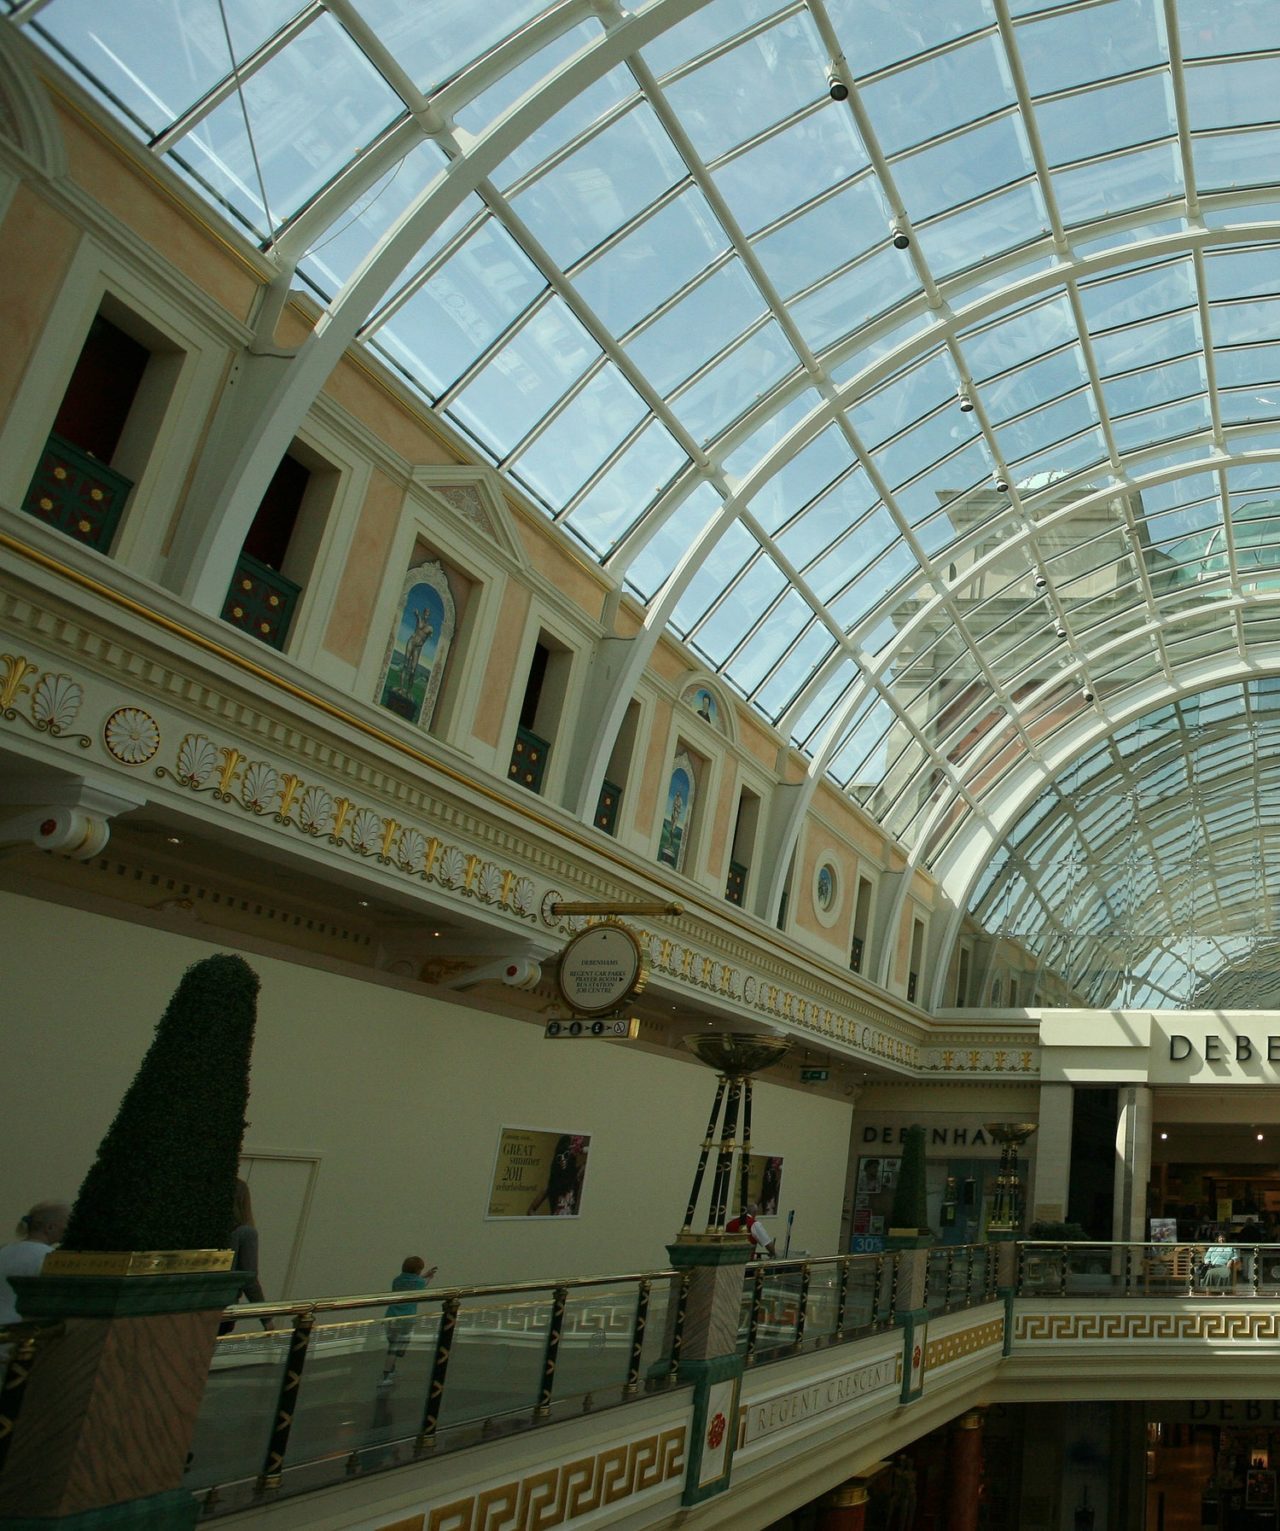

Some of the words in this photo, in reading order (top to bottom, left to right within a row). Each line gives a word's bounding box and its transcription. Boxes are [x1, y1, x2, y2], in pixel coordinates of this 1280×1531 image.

[503, 1143, 537, 1156] GREAT
[502, 1166, 523, 1181] 2011
[758, 1389, 820, 1431] REGENT
[827, 1364, 889, 1403] CRESCENT
